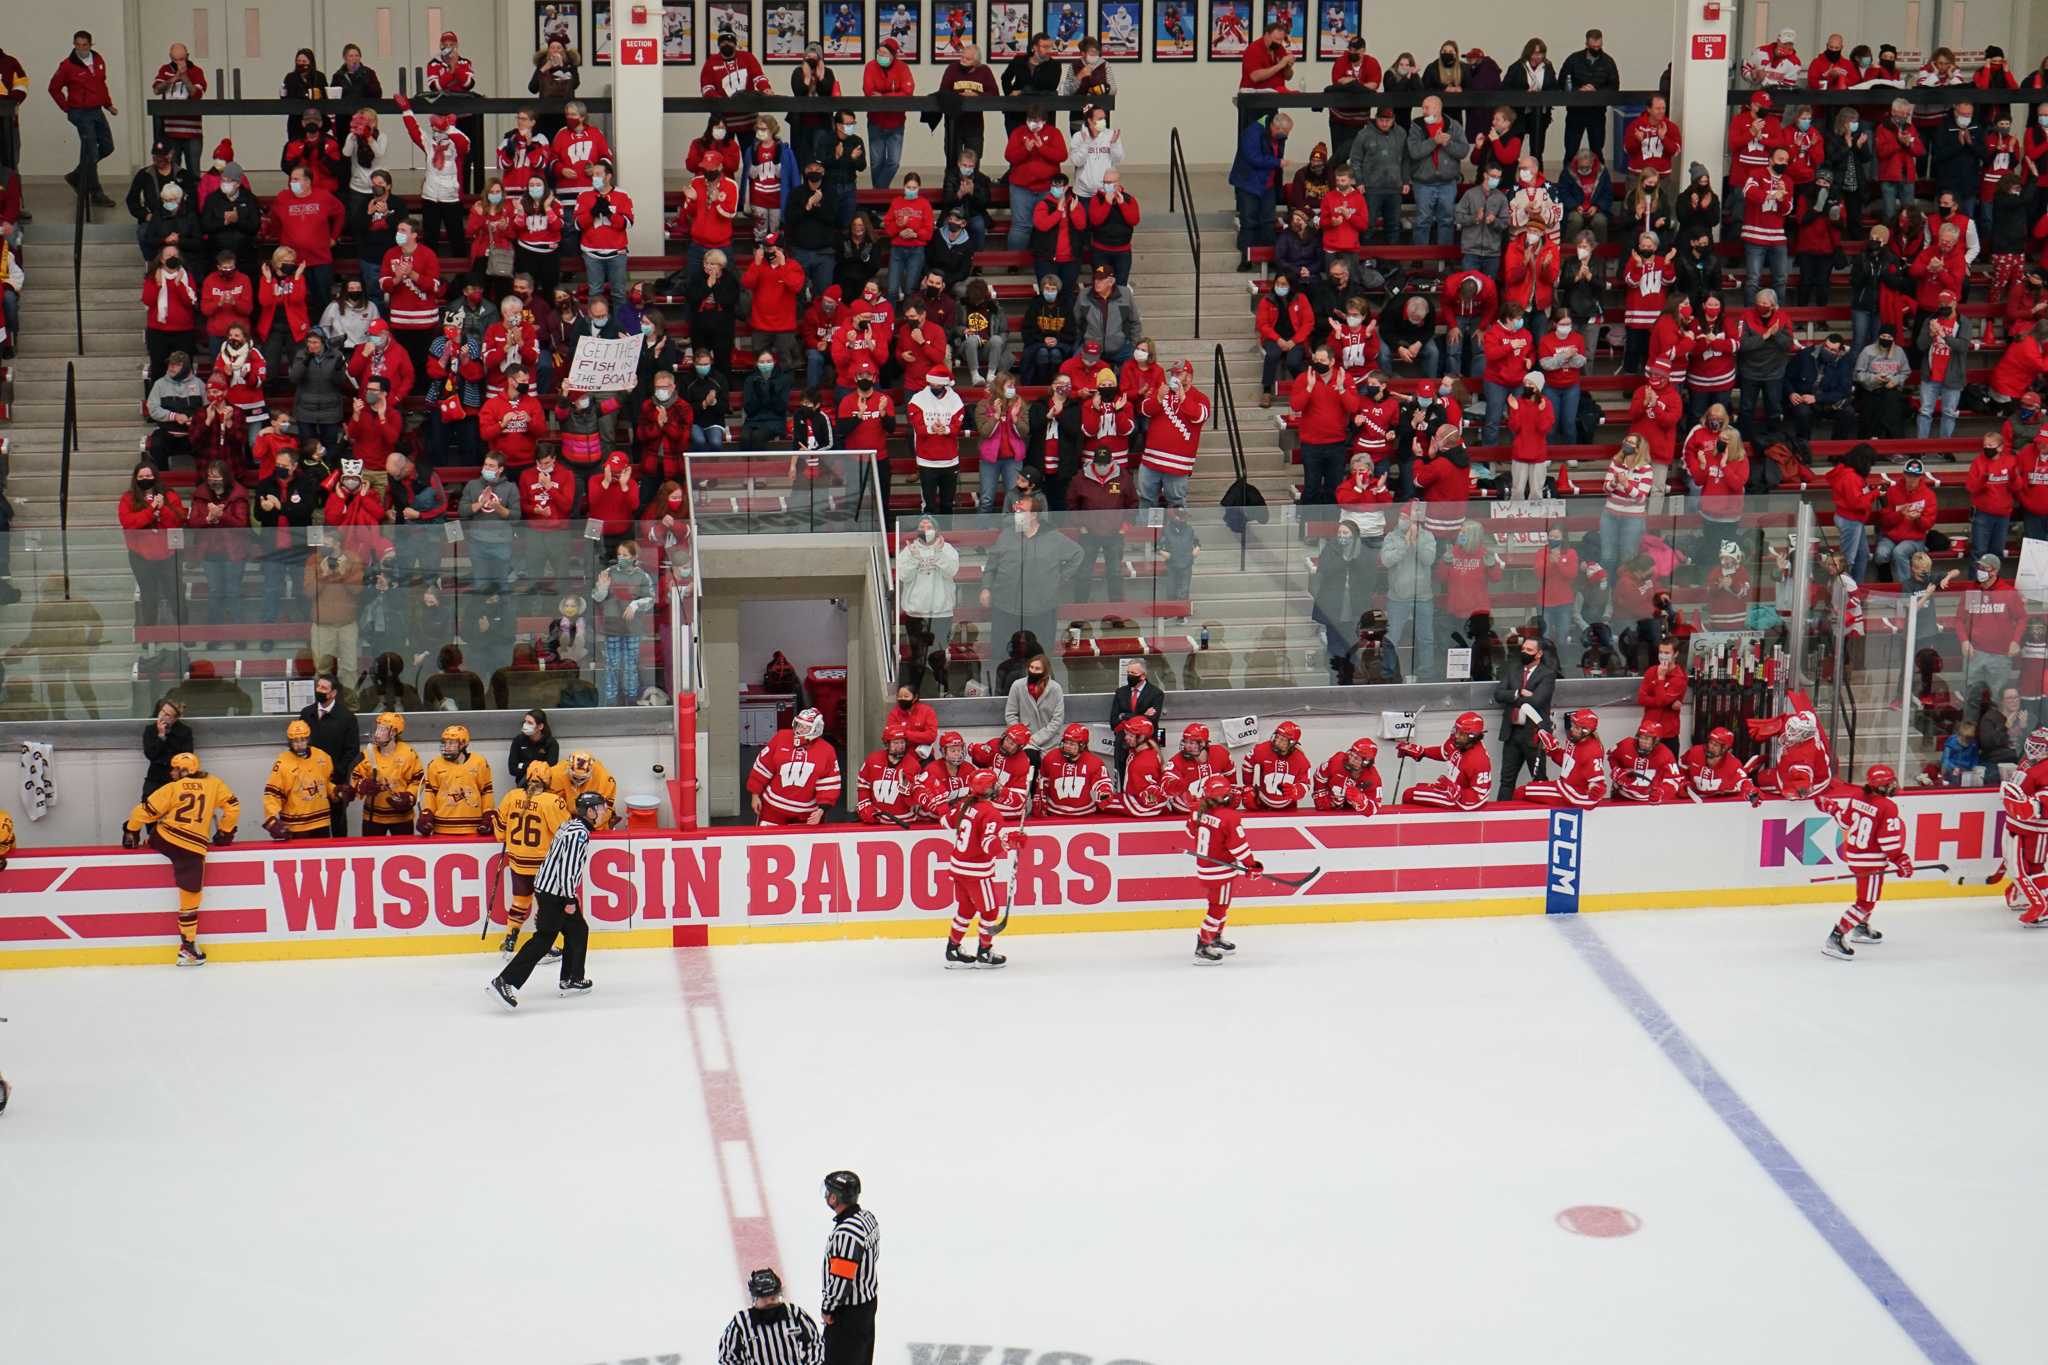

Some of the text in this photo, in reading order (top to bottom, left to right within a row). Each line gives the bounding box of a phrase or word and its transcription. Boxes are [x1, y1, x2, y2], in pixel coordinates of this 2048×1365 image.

[626, 40, 653, 48] SECTION
[1704, 44, 1713, 58] 5
[635, 49, 644, 63] 4
[583, 342, 612, 359] GET
[578, 360, 616, 372] FISH
[576, 371, 633, 385] THE BOAT
[1238, 729, 1258, 739] GATO
[779, 762, 816, 788] W
[182, 782, 203, 791] ODEN
[872, 779, 900, 805] W
[1054, 776, 1086, 800] W
[174, 792, 206, 824] 21
[509, 811, 541, 848] 26
[1847, 811, 1873, 850] 28
[1886, 817, 1901, 832] 28
[1197, 825, 1211, 857] 8
[1551, 811, 1579, 896] CCM
[273, 845, 721, 932] WISCSIN
